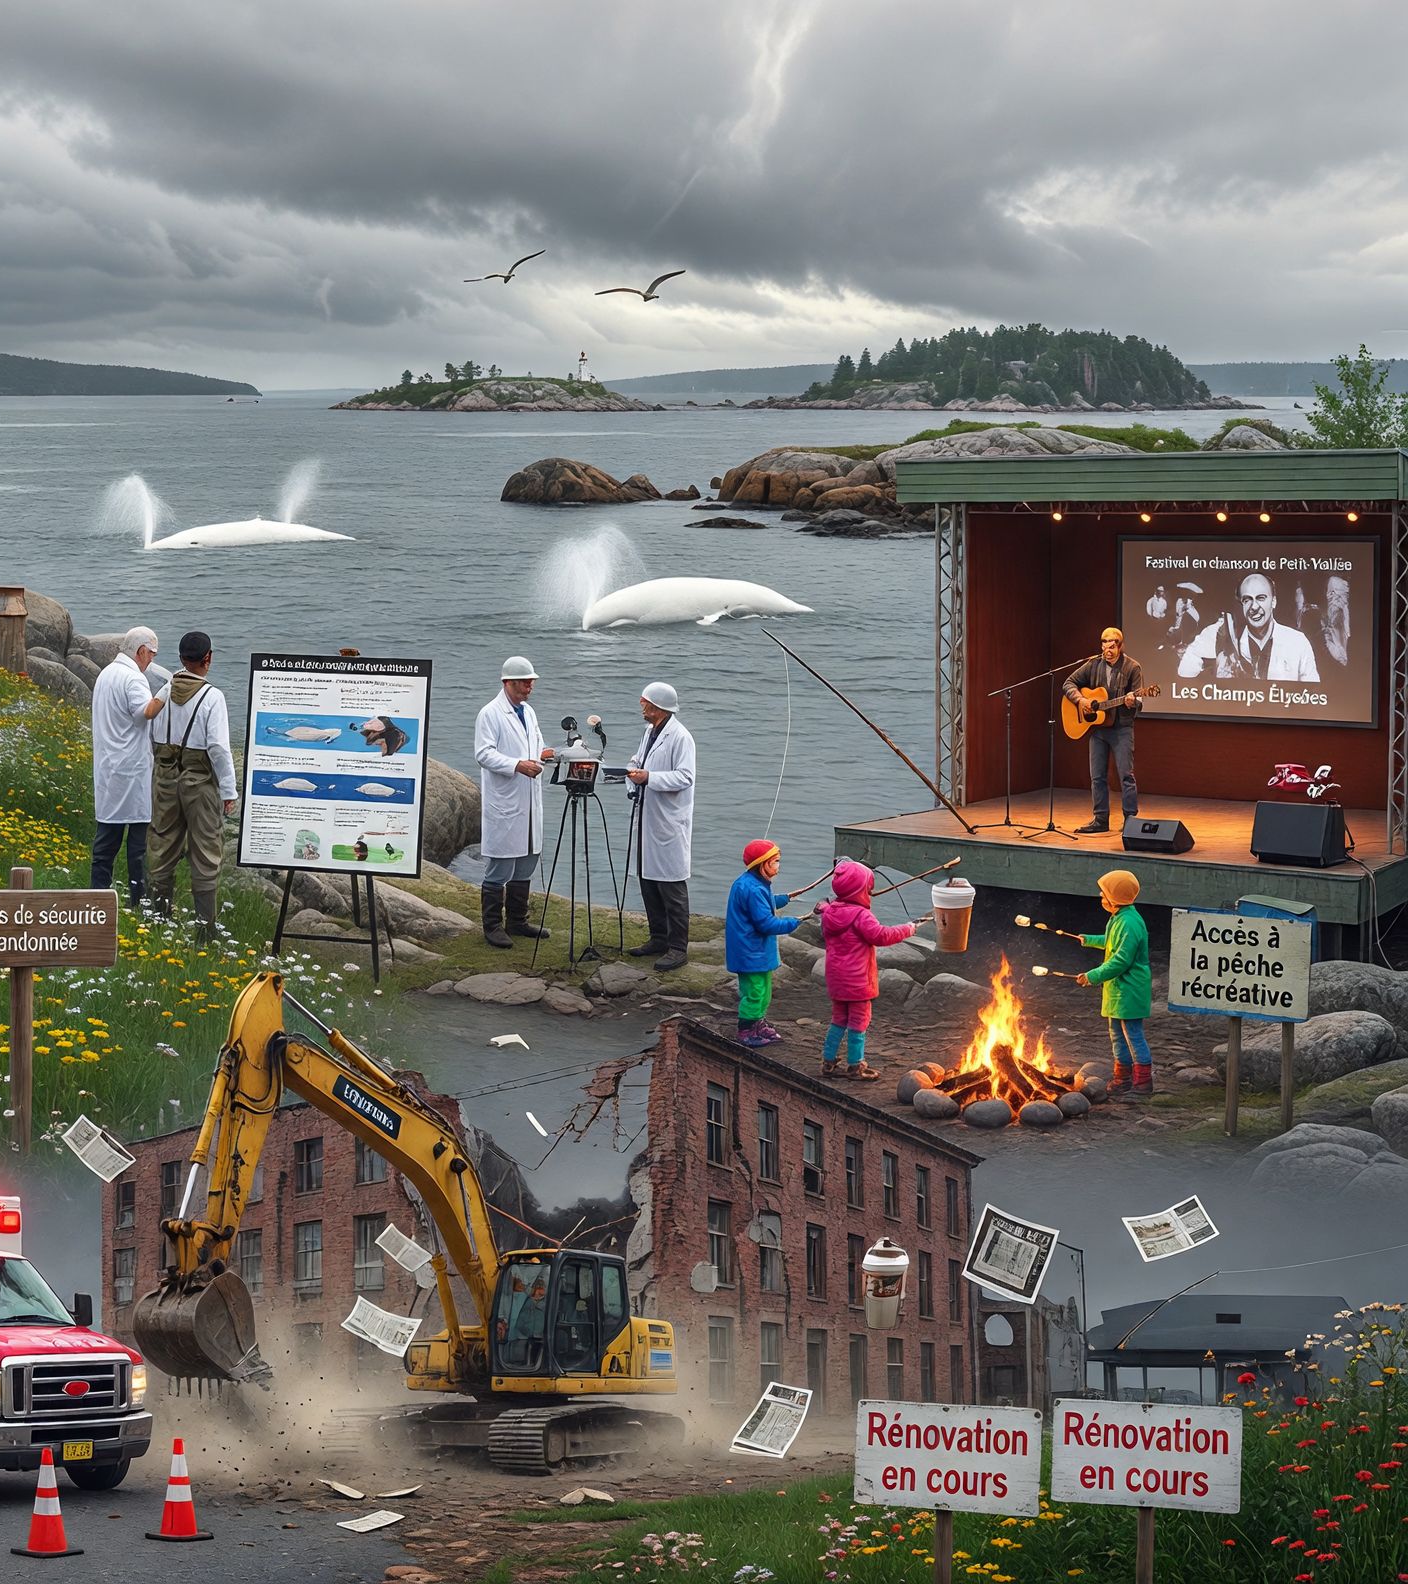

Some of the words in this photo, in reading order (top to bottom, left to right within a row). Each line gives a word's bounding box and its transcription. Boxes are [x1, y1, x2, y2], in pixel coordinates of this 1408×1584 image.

[1145, 556, 1189, 569] Festival
[1192, 558, 1206, 569] en
[1209, 557, 1259, 570] chanson
[1262, 557, 1276, 570] de
[1172, 683, 1198, 699] Les
[1202, 684, 1264, 706] Champs
[14, 904, 34, 925] de
[1267, 926, 1280, 948] à
[1190, 948, 1209, 970] la
[1217, 952, 1284, 978] pêche
[1181, 975, 1293, 1008] récréative
[868, 1412, 1028, 1456] Rénovation
[1064, 1411, 1229, 1455] Rénovation
[882, 1465, 916, 1491] en
[926, 1467, 1009, 1499] cours
[1080, 1465, 1114, 1490] en
[1126, 1466, 1210, 1498] cours
